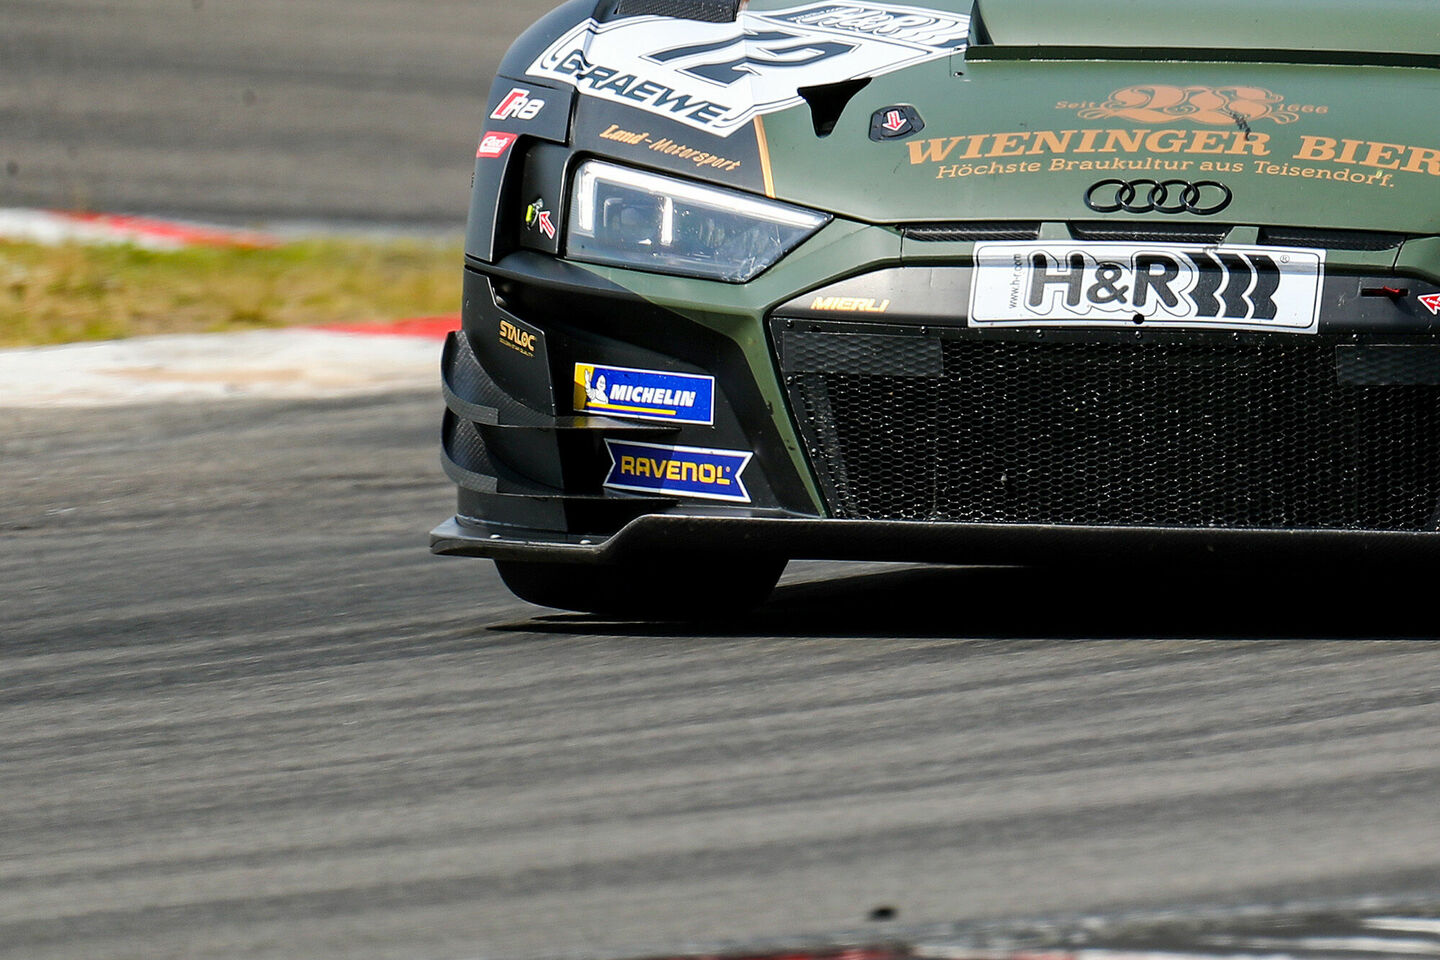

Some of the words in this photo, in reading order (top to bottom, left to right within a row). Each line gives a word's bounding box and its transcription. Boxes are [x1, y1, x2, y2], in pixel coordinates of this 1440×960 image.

[552, 48, 732, 125] GRAEWE
[492, 90, 546, 120] R8
[1055, 100, 1097, 110] Seit
[905, 129, 1272, 164] WIENINGER
[936, 160, 1041, 179] Höchste
[1048, 157, 1194, 172] Braukultur
[1199, 161, 1244, 173] aus
[1253, 160, 1396, 188] Teisendorf.
[1028, 251, 1182, 309] H&R
[499, 319, 537, 352] STALOC
[609, 382, 697, 408] MICHELIN
[619, 454, 732, 486] RAVENOL
